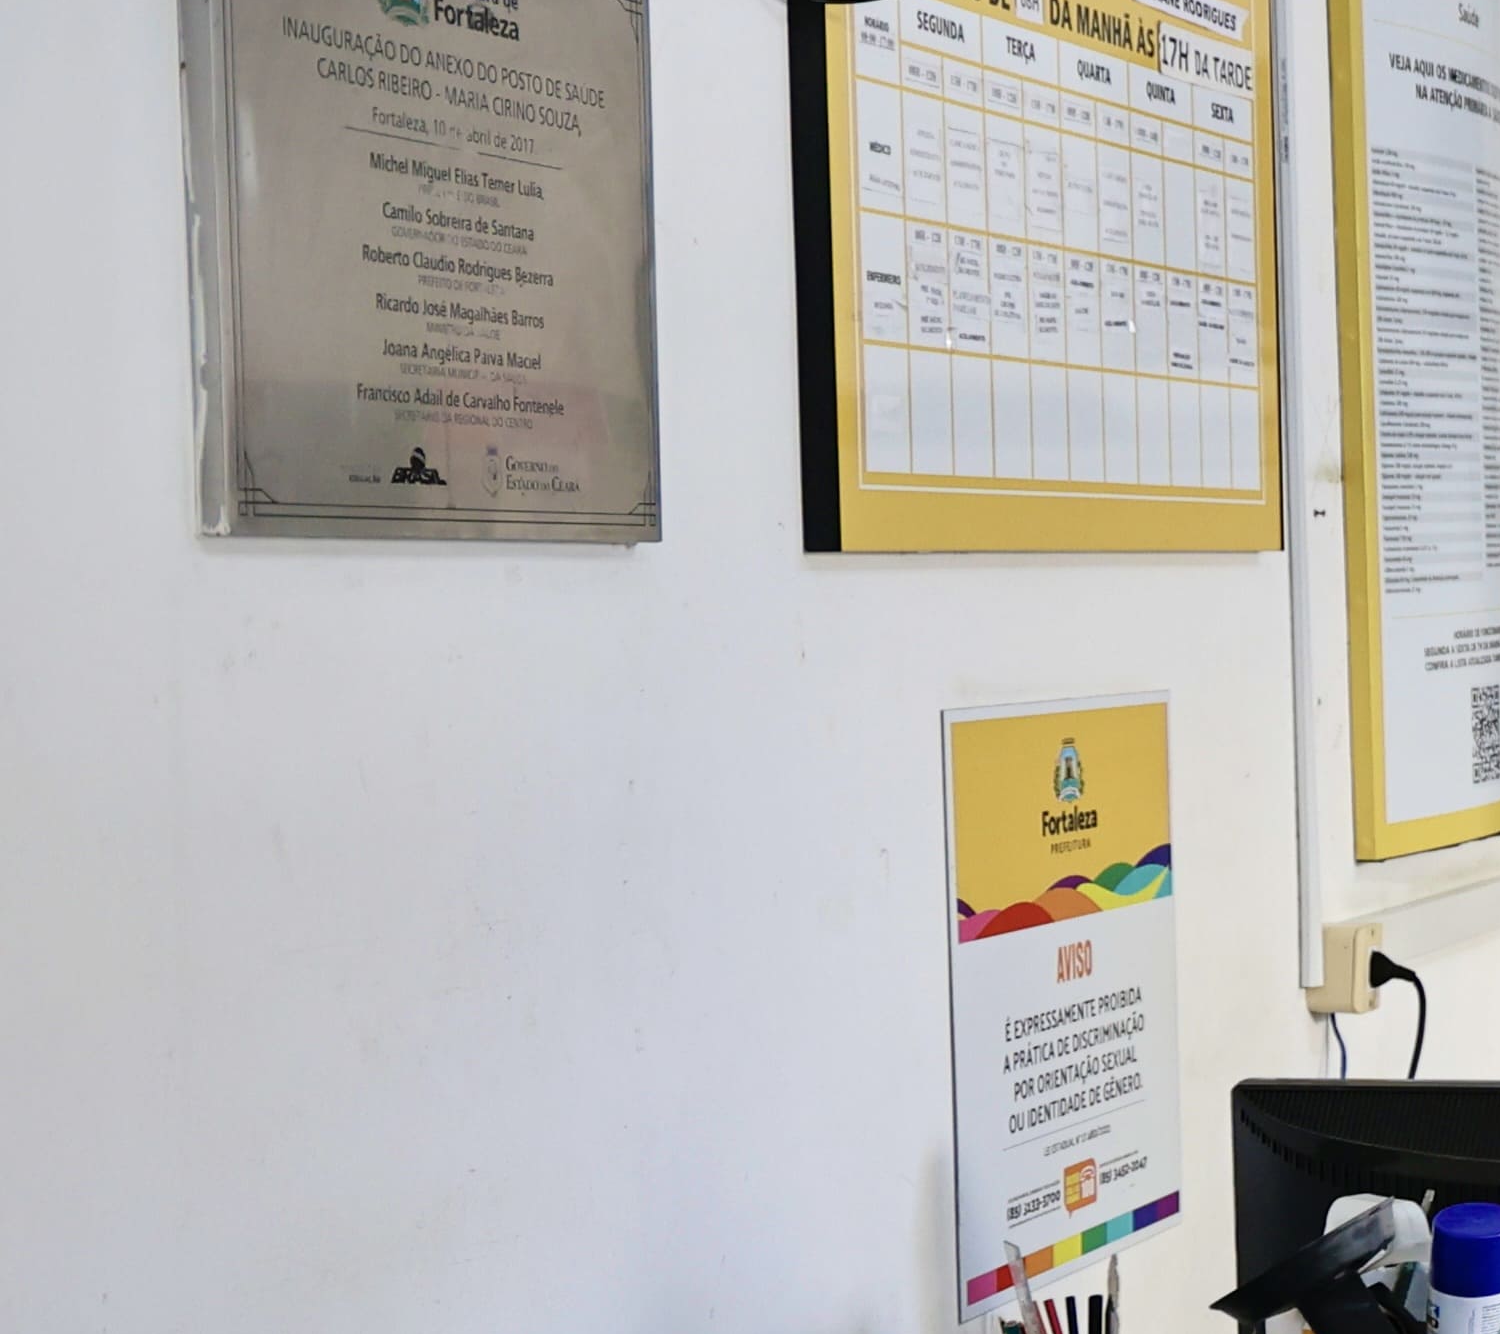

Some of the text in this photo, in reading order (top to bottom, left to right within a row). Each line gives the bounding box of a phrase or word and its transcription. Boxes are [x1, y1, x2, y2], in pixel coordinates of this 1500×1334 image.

[917, 10, 965, 44] SEGUNDA
[1458, 3, 1480, 28] Saúde
[282, 15, 605, 109] INAUGURAÇÃO DO ANEXO DO POSTO DE SAÚDE
[1005, 35, 1036, 65] TERÇA
[1076, 3, 1133, 51] MANHÃ
[1136, 18, 1155, 58] ÀS
[1161, 34, 1190, 72] 17H
[1194, 50, 1209, 77] DA
[1212, 56, 1254, 91] TARDE
[1076, 59, 1112, 85] QUARTA
[1389, 52, 1447, 80] VEJA AQUI OS
[317, 57, 374, 89] CARLOS
[378, 70, 432, 101] RIBEIRO
[445, 86, 489, 113] MARIA
[493, 96, 535, 123] CIRINO
[1146, 81, 1177, 105] QUINTA
[1415, 84, 1463, 112] NA ATENÇÃO
[372, 106, 430, 136] Fortaleza,
[433, 118, 446, 137] 10
[493, 131, 508, 150] de
[1210, 102, 1235, 124] SEXTA
[370, 152, 408, 175] Michel
[412, 160, 451, 183] Miguel
[454, 168, 479, 188] Elias
[482, 173, 515, 194] Temer
[382, 201, 535, 242] Camilo Sobreira de Santana
[362, 244, 554, 288] Roberto Claudio Rodrigues Bezerra
[376, 293, 545, 329] Ricardo José Magalhães Barros
[383, 339, 542, 370] Joana Angélica Paiva Maciel
[356, 382, 565, 416] Francisco Adail de Carvalho Fontenele
[391, 467, 447, 486] BRASIL
[1042, 805, 1098, 837] Fortaleza
[1050, 837, 1091, 855] PREFEITURA
[1057, 939, 1093, 984] AVISO
[1004, 986, 1142, 1042] É EXPRESSAMENTE PROIBIDA
[1003, 1012, 1144, 1075] A PRÁTICA DE DISCRIMINAÇÃO
[1014, 1045, 1137, 1102] POR ORIENTAÇÃO SEXUAL
[1009, 1112, 1025, 1134] OU
[1026, 1091, 1087, 1129] IDENTIDADE
[1089, 1085, 1102, 1107] DE
